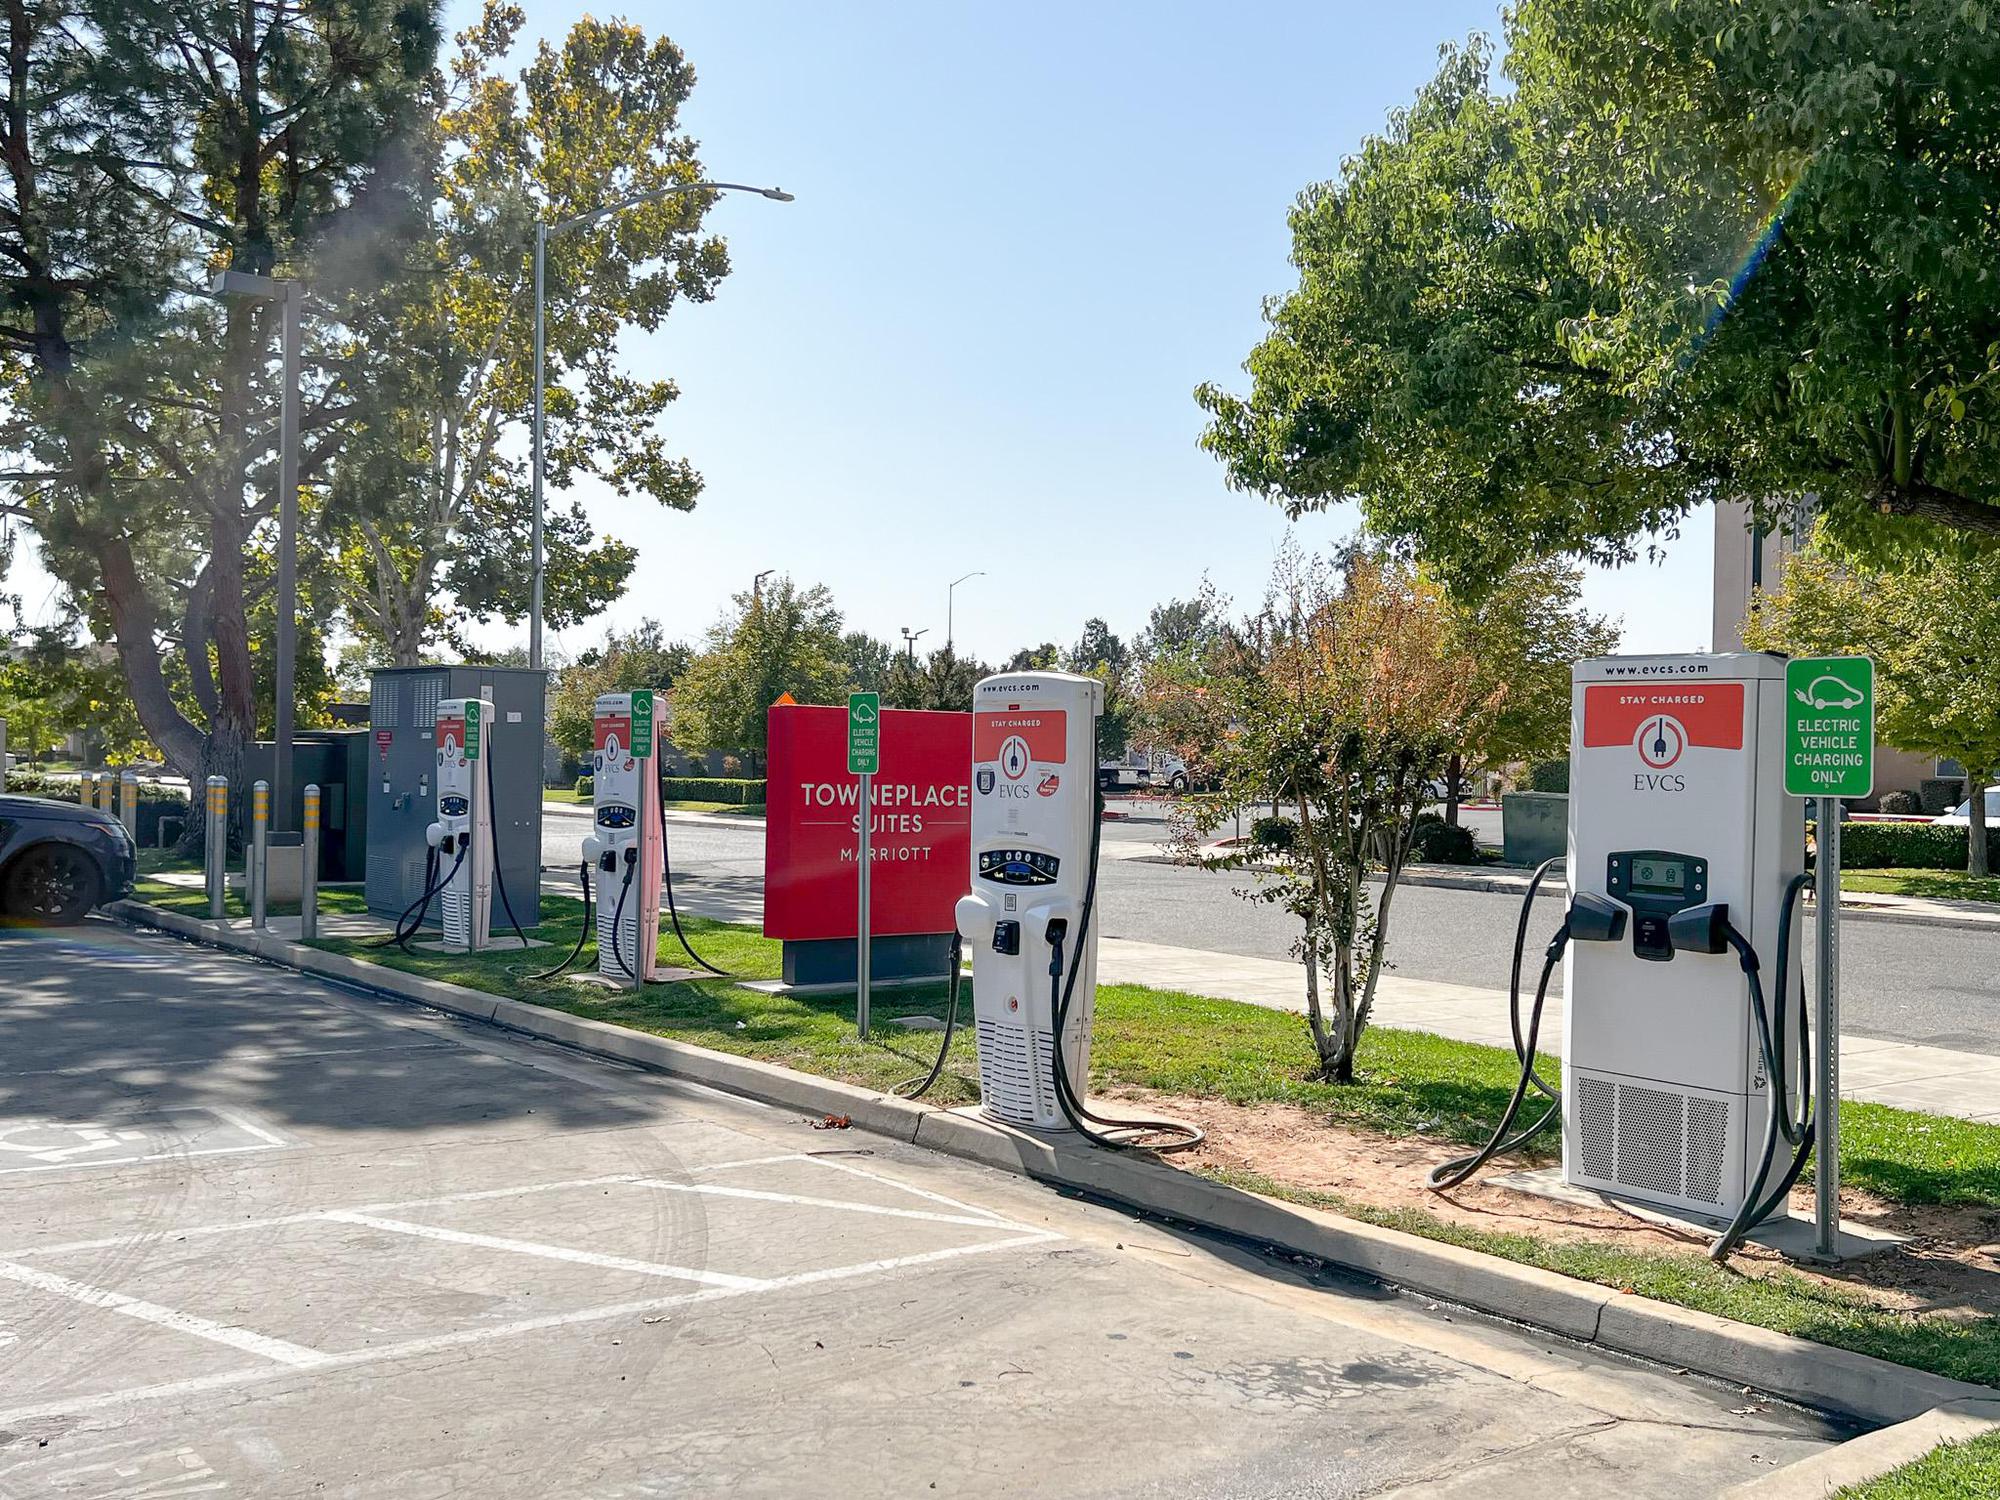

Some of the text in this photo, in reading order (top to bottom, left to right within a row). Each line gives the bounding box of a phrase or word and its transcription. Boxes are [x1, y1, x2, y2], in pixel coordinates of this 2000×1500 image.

[1605, 664, 1709, 676] www.evcs.com
[983, 684, 1040, 693] www.evcs.com
[1619, 695, 1705, 705] STAY CHARGED
[991, 719, 1041, 727] STAY CHARGED
[1797, 719, 1861, 732] ELECTRIC
[852, 728, 875, 737] ELECTRIC
[853, 738, 874, 746] VEHICLE
[1800, 736, 1857, 749] VEHICLE
[851, 748, 876, 756] CHARGING
[857, 758, 870, 767] ONLY
[1794, 753, 1863, 766] CHARGING
[1811, 770, 1846, 783] ONLY
[1633, 774, 1685, 792] EVCS
[801, 783, 969, 807] TOWNEPLACE
[999, 784, 1030, 799] EVCS
[851, 814, 923, 833] SUITES
